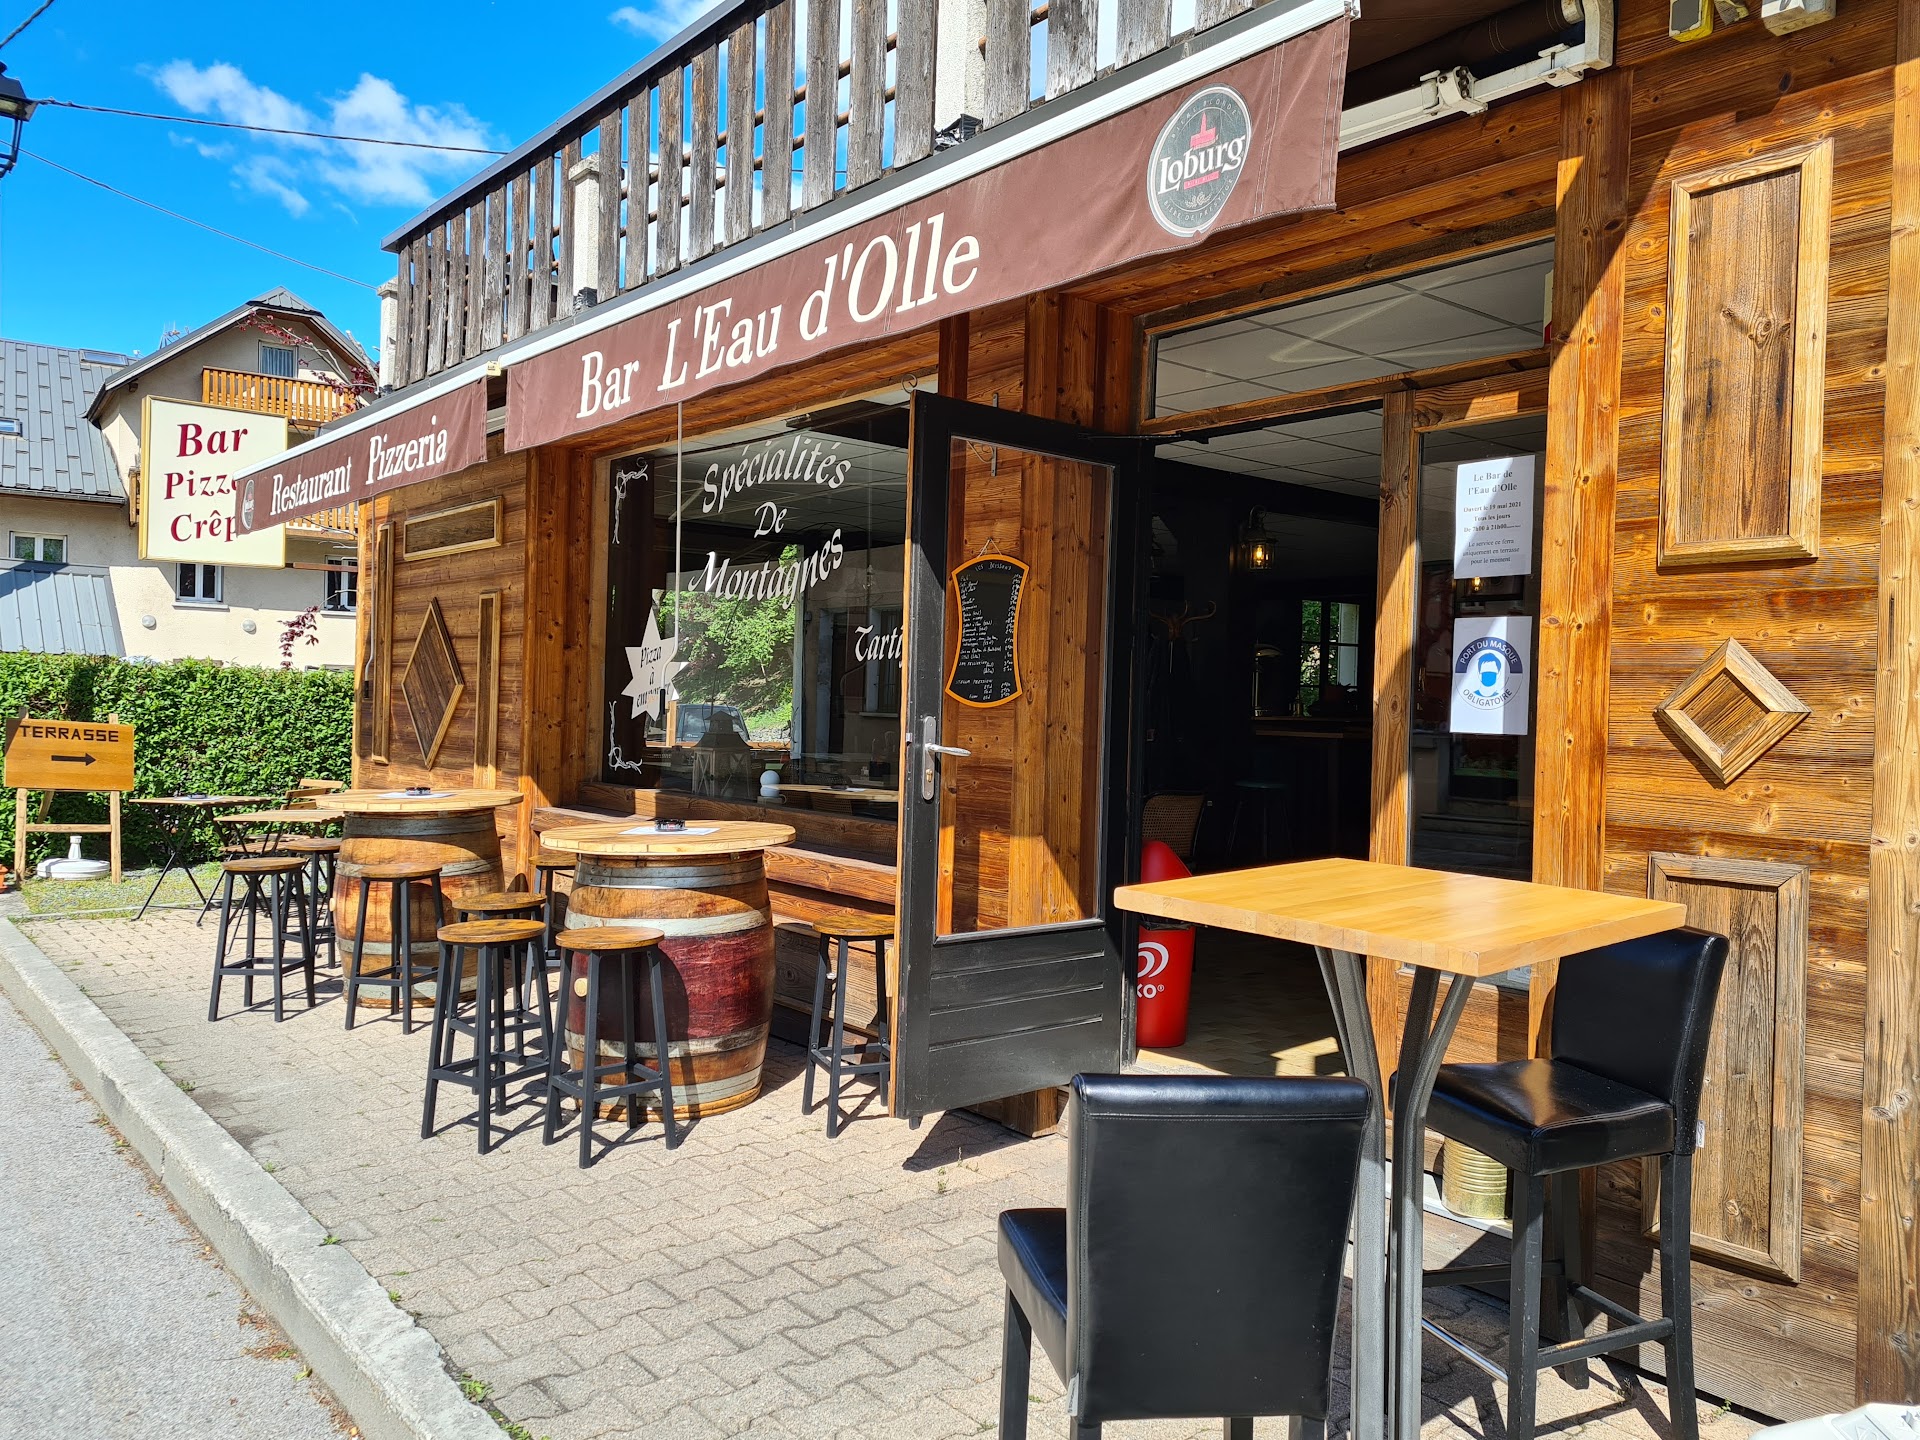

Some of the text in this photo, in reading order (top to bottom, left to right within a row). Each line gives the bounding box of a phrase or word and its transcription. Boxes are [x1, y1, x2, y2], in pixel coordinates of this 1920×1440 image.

[1157, 134, 1246, 195] Loburg
[576, 212, 980, 419] Bar L'Eau d'Olle
[176, 423, 248, 458] Bar
[270, 415, 448, 516] Restaurant Pizzeria
[702, 434, 852, 514] Spécialités
[1473, 470, 1513, 482] Le Bar de
[754, 501, 788, 538] De
[1496, 513, 1511, 521] jours
[688, 528, 844, 610] Montagnes
[640, 646, 662, 668] Pizza
[1460, 640, 1518, 665] PORT DU MASQUE
[649, 666, 655, 685] à
[1462, 688, 1513, 707] OBLIGATOIRE
[19, 725, 119, 742] TERRASSE
